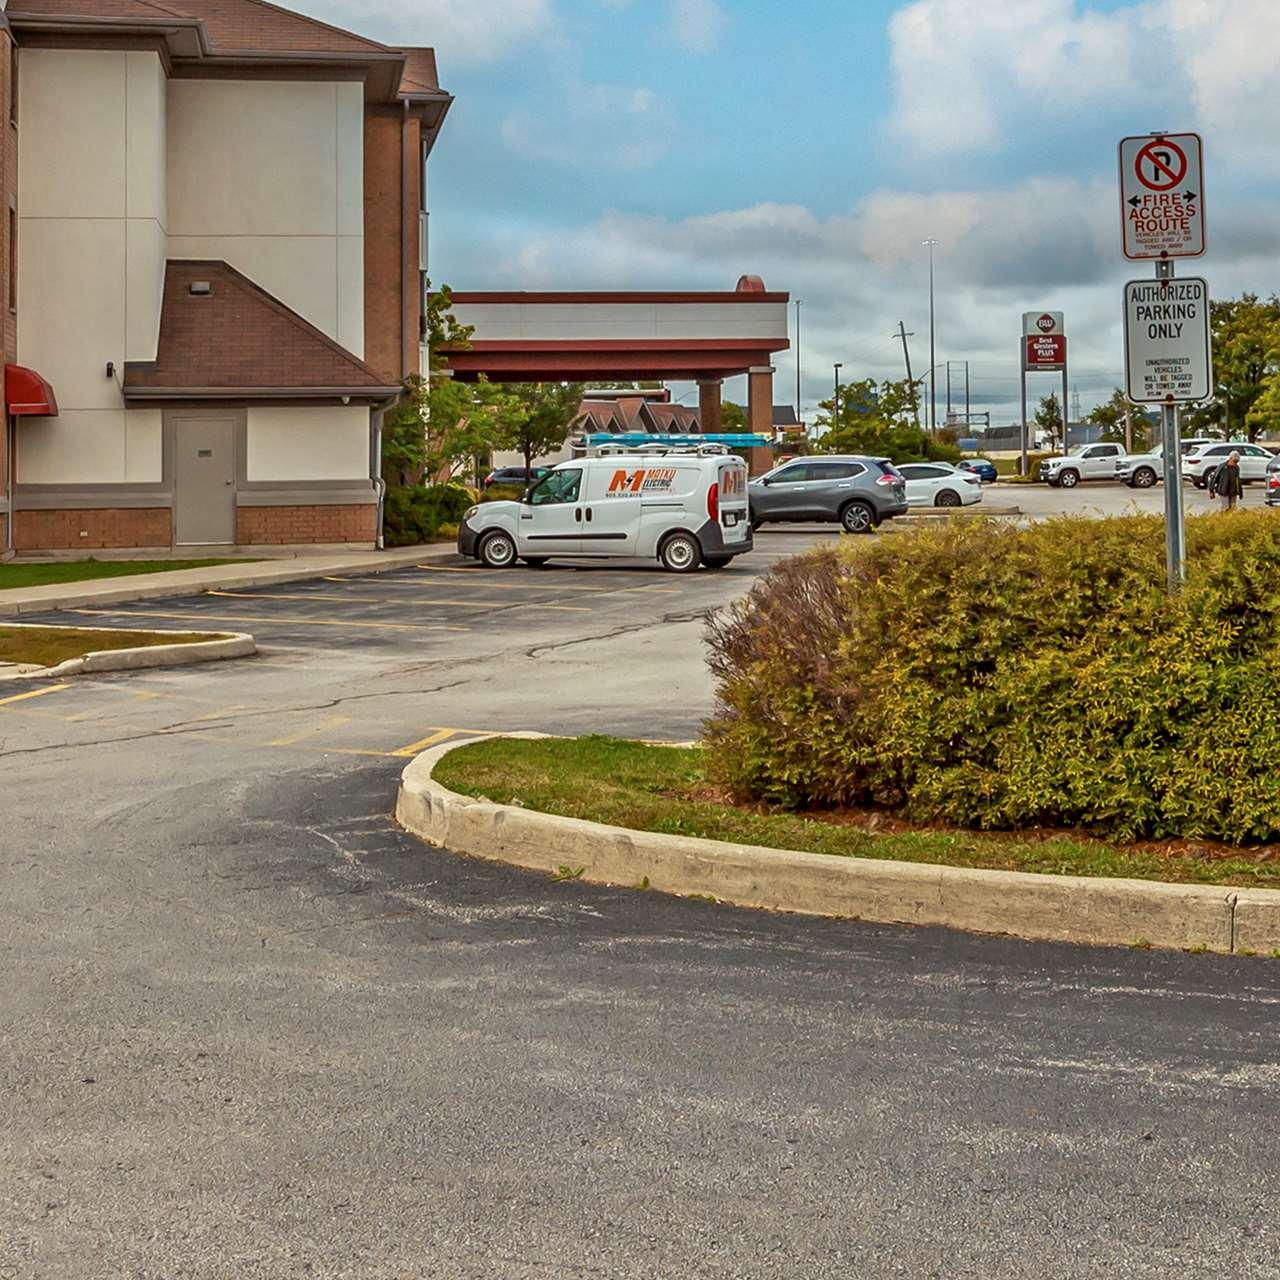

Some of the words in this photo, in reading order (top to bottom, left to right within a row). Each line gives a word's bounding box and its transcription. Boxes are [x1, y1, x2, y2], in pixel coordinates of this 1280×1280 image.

[1143, 192, 1181, 207] FIRE
[1129, 204, 1196, 220] ACCESS
[1135, 217, 1190, 232] ROUTE
[1131, 284, 1202, 302] AUTHORIZED
[1136, 303, 1196, 321] PARKING
[1148, 323, 1183, 339] ONLY
[1145, 358, 1190, 366] UNAUTHORIZED
[1153, 366, 1182, 374] VEHICLES
[642, 479, 673, 487] ELECTRIC
